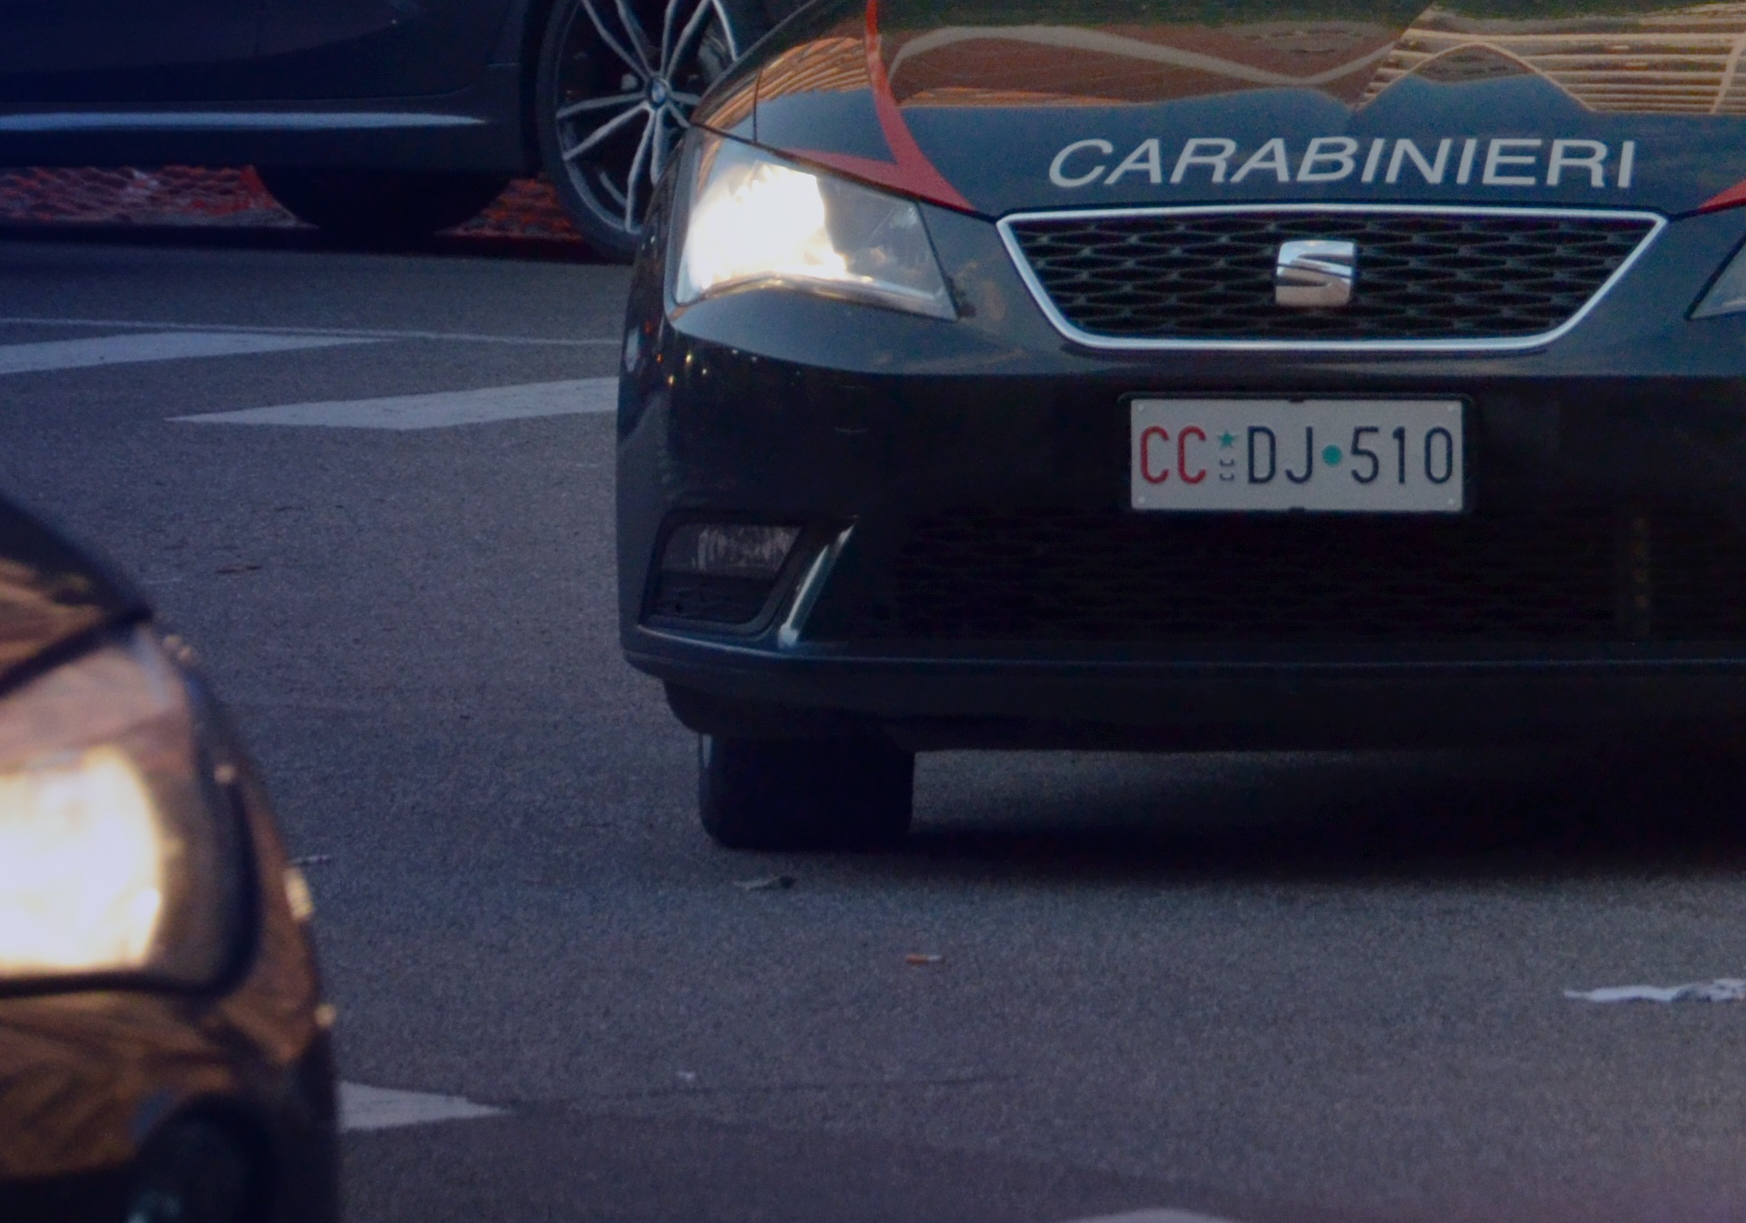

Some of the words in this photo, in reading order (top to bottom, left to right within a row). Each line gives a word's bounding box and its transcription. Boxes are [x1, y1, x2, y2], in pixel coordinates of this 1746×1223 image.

[1049, 137, 1635, 189] CARABINIERI
[1140, 426, 1208, 485] CC
[1247, 426, 1314, 485] DJ
[1349, 426, 1454, 485] 510
